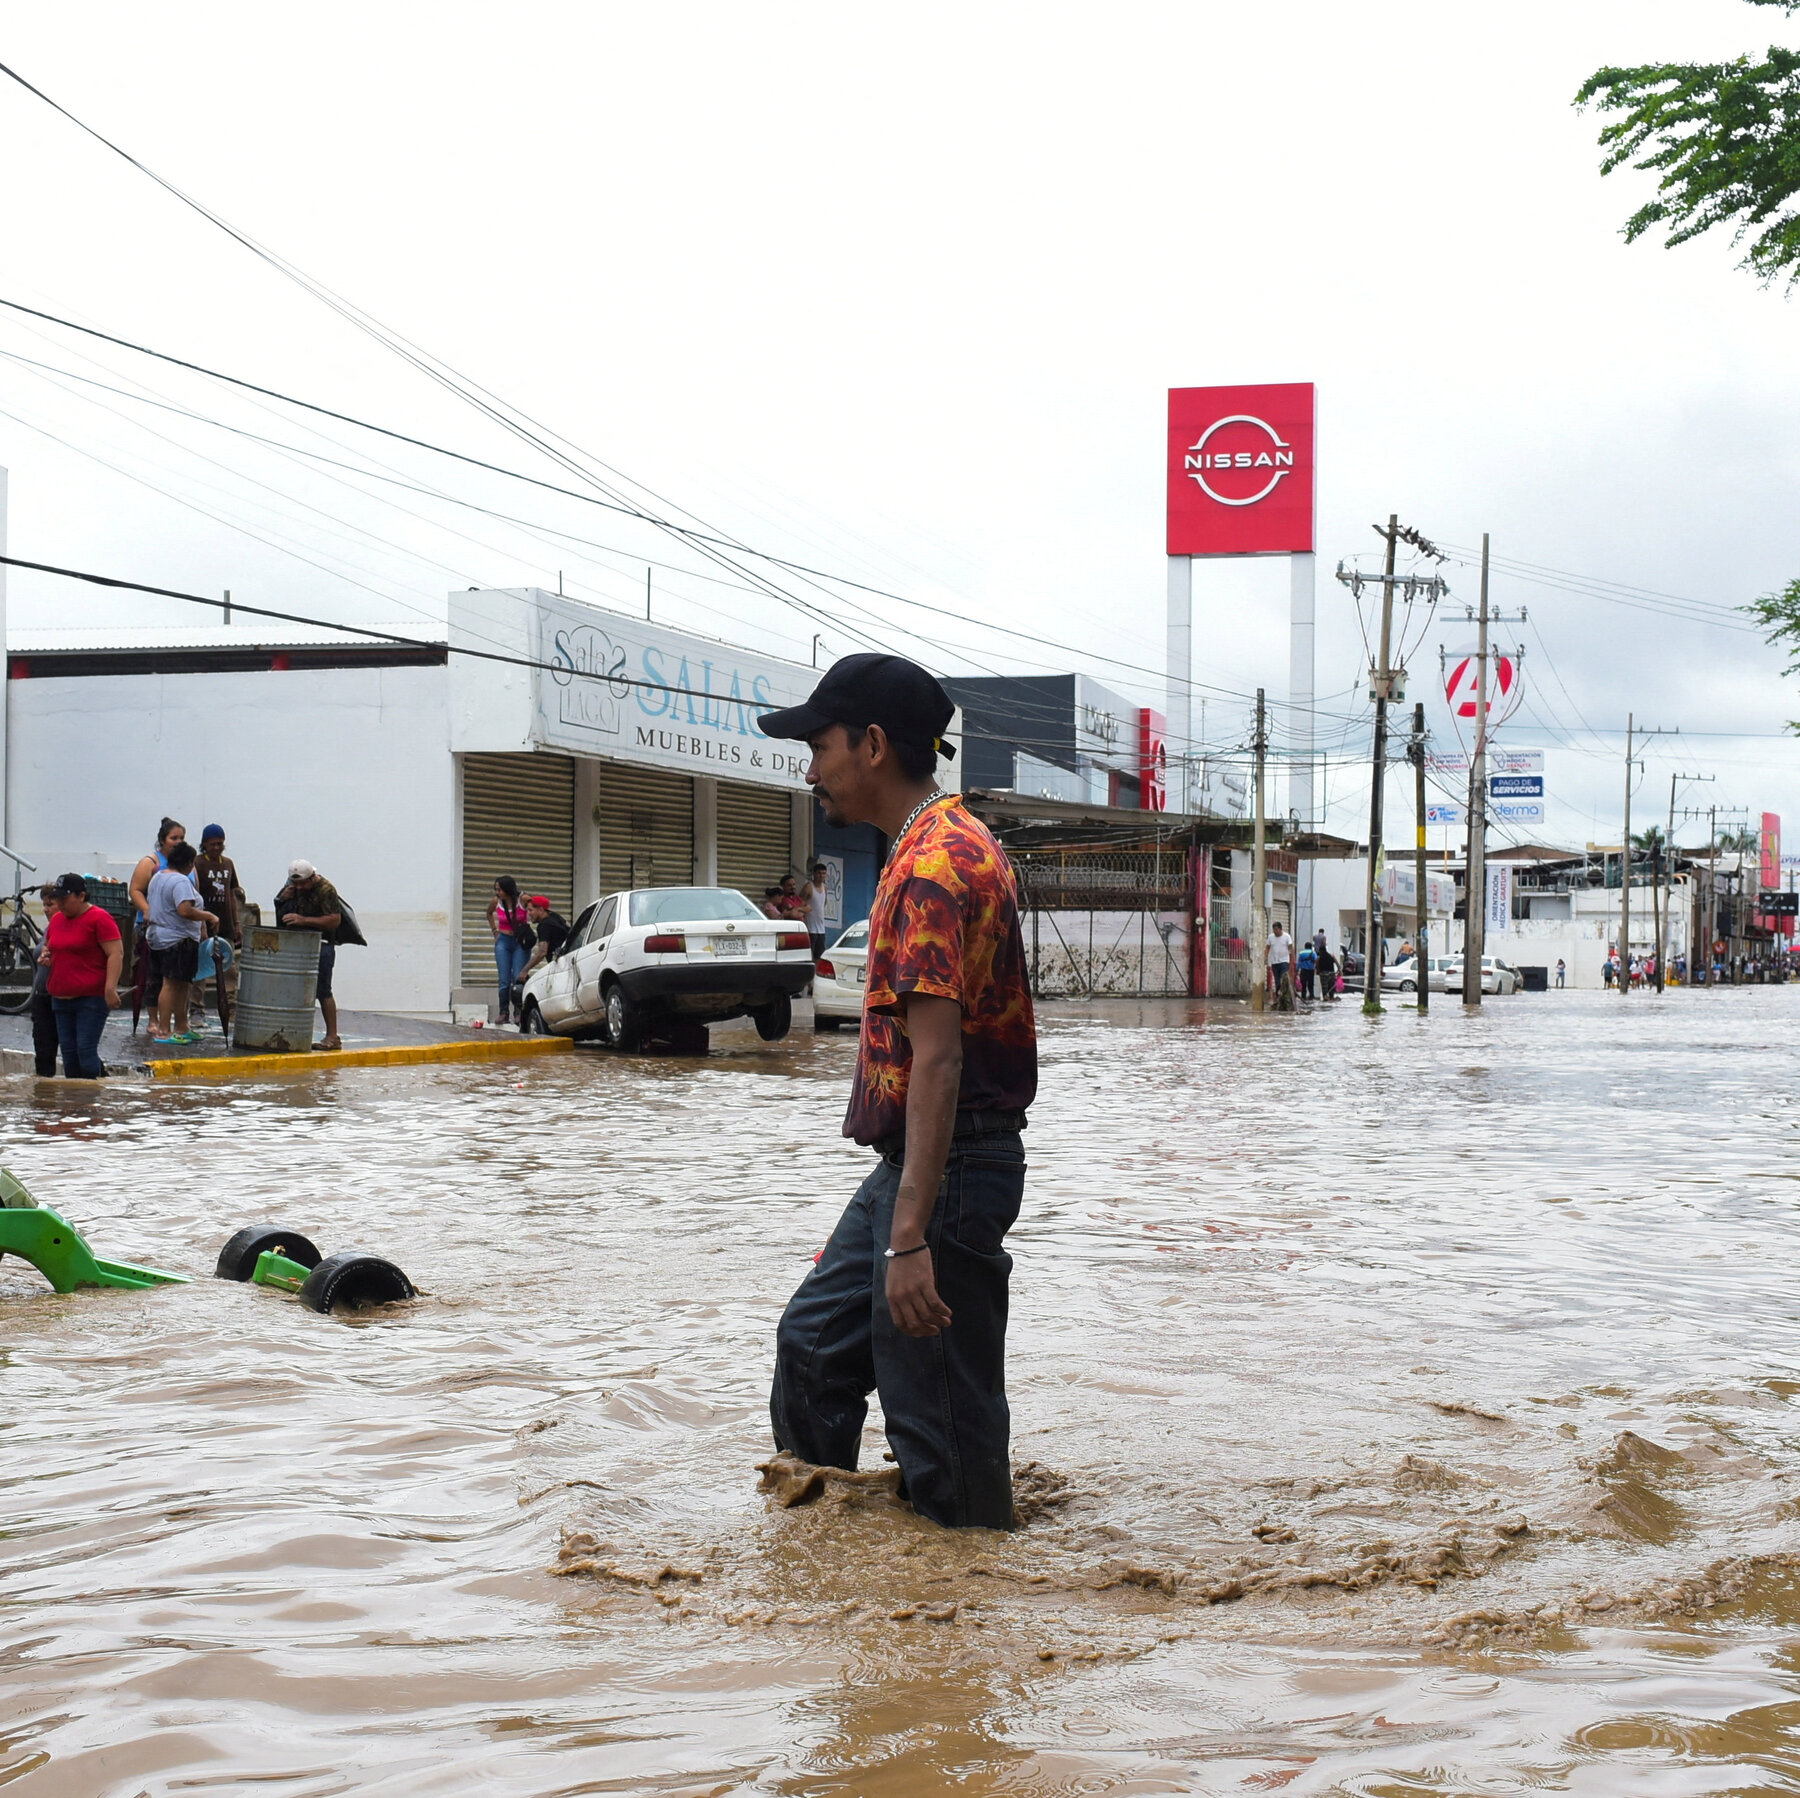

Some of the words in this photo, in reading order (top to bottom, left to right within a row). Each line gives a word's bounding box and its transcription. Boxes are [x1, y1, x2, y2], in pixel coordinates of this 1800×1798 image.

[1184, 451, 1294, 470] NISSAN
[635, 645, 775, 740] SALAS
[635, 725, 742, 764] MUEBLES
[750, 750, 764, 768] &
[1492, 785, 1541, 794] SERVICIOS
[1494, 804, 1539, 816] derma
